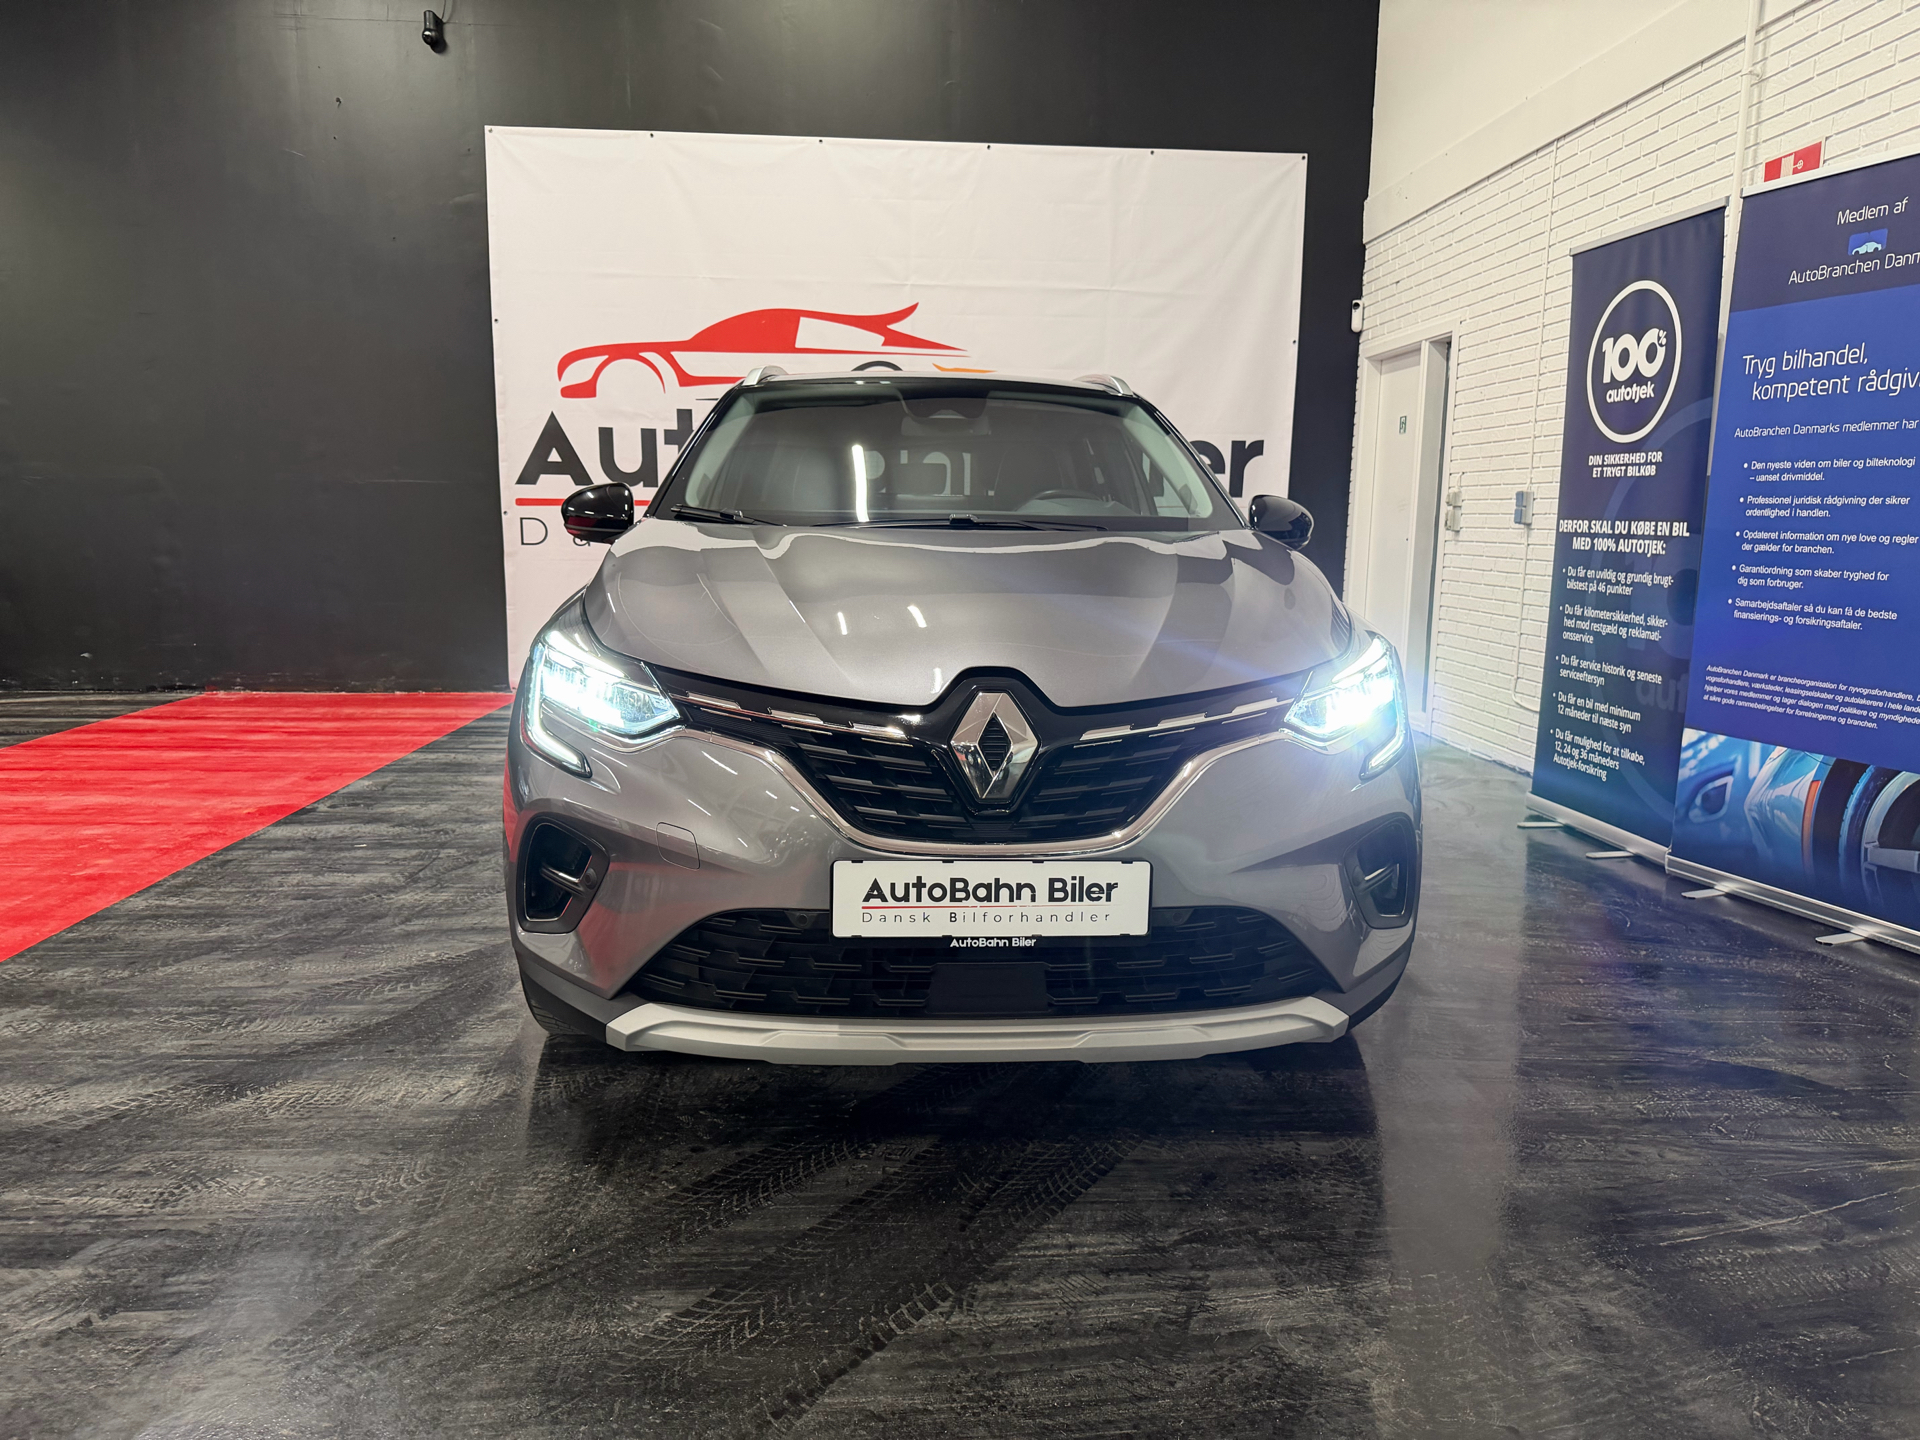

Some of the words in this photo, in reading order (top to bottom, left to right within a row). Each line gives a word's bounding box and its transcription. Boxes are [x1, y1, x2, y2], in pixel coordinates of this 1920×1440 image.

[1837, 204, 1889, 225] Medlem
[1894, 197, 1909, 214] af
[1788, 258, 1880, 284] AutoBranchen
[1743, 355, 1775, 378] Tryg
[1782, 342, 1868, 371] bilhandel,
[1606, 381, 1654, 403] autotjek
[1752, 377, 1850, 402] kompetent
[1858, 368, 1920, 396] rådgiv
[1734, 426, 1790, 438] AutoBranchen
[1793, 424, 1840, 435] Danmarks
[1843, 420, 1899, 432] medlemmer
[1902, 419, 1919, 429] har
[1589, 455, 1602, 465] DIN
[1604, 453, 1646, 465] SIKKERHED
[1648, 452, 1662, 462] FOR
[1767, 462, 1791, 471] nyeste
[1794, 460, 1815, 469] viden
[1833, 458, 1851, 468] biler
[1853, 460, 1864, 469] og
[1866, 457, 1916, 468] bilteknologi
[1593, 468, 1601, 477] ET
[1603, 466, 1625, 477] TRYGT
[1627, 465, 1656, 476] BILKØB
[1756, 473, 1779, 482] uanset
[1781, 472, 1825, 481] drivmiddel.
[1747, 496, 1791, 504] Professionel
[1792, 496, 1821, 506] juridisk
[1823, 496, 1866, 506] rådgivning
[1869, 496, 1883, 505] der
[1885, 496, 1910, 505] sikrer
[1746, 508, 1790, 518] ordentlighed
[1796, 509, 1830, 517] handlen.
[1559, 520, 1588, 532] DERFOR
[1590, 520, 1612, 533] SKAL
[1615, 521, 1628, 534] DU
[1631, 521, 1654, 535] KØBE
[1657, 522, 1669, 536] EN
[1672, 522, 1689, 536] BIL
[1743, 530, 1778, 541] Opdateret
[1780, 531, 1824, 541] information
[1826, 534, 1839, 542] om
[1842, 534, 1857, 544] nye
[1859, 533, 1876, 542] love
[1878, 535, 1890, 544] og
[1892, 534, 1919, 545] regler
[1573, 537, 1591, 550] MED
[1594, 538, 1616, 552] 100%
[1618, 539, 1666, 557] AUTOTJEK:
[1742, 542, 1752, 551] der
[1754, 543, 1780, 553] gælder
[1782, 543, 1793, 552] for
[1794, 544, 1834, 554] branchen.
[1568, 566, 1576, 576] Du
[1587, 570, 1595, 578] en
[1596, 569, 1616, 582] uvildig
[1618, 572, 1625, 583] og
[1627, 572, 1652, 586] grundig
[1654, 574, 1674, 588] brugt-
[1739, 564, 1793, 577] Garantiordning
[1795, 568, 1812, 576] som
[1814, 569, 1842, 578] skaber
[1844, 570, 1874, 582] tryghed
[1877, 572, 1889, 581] for
[1567, 579, 1587, 591] bilstest
[1589, 581, 1596, 593] på
[1598, 582, 1605, 592] 46
[1607, 583, 1632, 596] punkter
[1738, 577, 1748, 587] dig
[1767, 578, 1804, 589] forbruger.
[1565, 604, 1573, 614] Du
[1574, 605, 1583, 616] får
[1584, 606, 1645, 625] kilometersikkerhed,
[1647, 616, 1668, 628] sikker-
[1735, 598, 1802, 612] Samarbejdsaftaler
[1804, 603, 1813, 612] så
[1816, 605, 1826, 614] du
[1828, 606, 1842, 615] kan
[1845, 606, 1852, 616] få
[1855, 607, 1865, 617] de
[1868, 609, 1897, 620] bedste
[1564, 617, 1574, 628] hed
[1576, 619, 1589, 630] mod
[1591, 622, 1617, 635] restgæld
[1619, 627, 1626, 638] og
[1628, 627, 1661, 641] reklamati-
[1734, 610, 1782, 623] finansierings-
[1784, 616, 1793, 625] og
[1795, 615, 1862, 630] forsikringsaftaler.
[1563, 631, 1593, 643] onsservice
[1560, 668, 1604, 687] serviceeftersyn
[1561, 654, 1569, 664] Du
[1571, 656, 1579, 666] får
[1580, 660, 1600, 671] service
[1602, 662, 1625, 677] historik
[1627, 670, 1635, 681] og
[1637, 670, 1662, 684] seneste
[1706, 665, 1742, 675] AutoBranchen
[1743, 670, 1769, 679] Danmark
[1778, 675, 1837, 689] brancheorganisation
[1739, 690, 1772, 701] medlemmer
[1558, 692, 1566, 702] Du
[1568, 694, 1576, 704] får
[1577, 697, 1584, 706] en
[1595, 701, 1608, 712] med
[1610, 706, 1641, 721] minimum
[1888, 702, 1902, 710] hele
[1558, 705, 1564, 714] 12
[1565, 706, 1591, 721] måneder
[1600, 716, 1618, 729] næste
[1619, 722, 1631, 734] syn
[1556, 728, 1564, 739] Du
[1565, 731, 1573, 742] får
[1574, 734, 1602, 751] mulighed
[1603, 742, 1612, 754] for
[1613, 746, 1620, 756] at
[1621, 748, 1645, 765] tilkøbe,
[1564, 744, 1570, 754] 24
[1572, 748, 1579, 759] og
[1580, 749, 1587, 759] 36
[1588, 751, 1619, 770] måneders
[1553, 753, 1607, 782] Autotjek-forsikring
[862, 876, 1037, 903] AutoBahn
[1048, 876, 1118, 903] Biler
[862, 912, 931, 922] Dansk
[949, 912, 1110, 923] Bilforhandler
[950, 937, 1009, 948] AutoBahn
[1012, 937, 1036, 947] Biler
